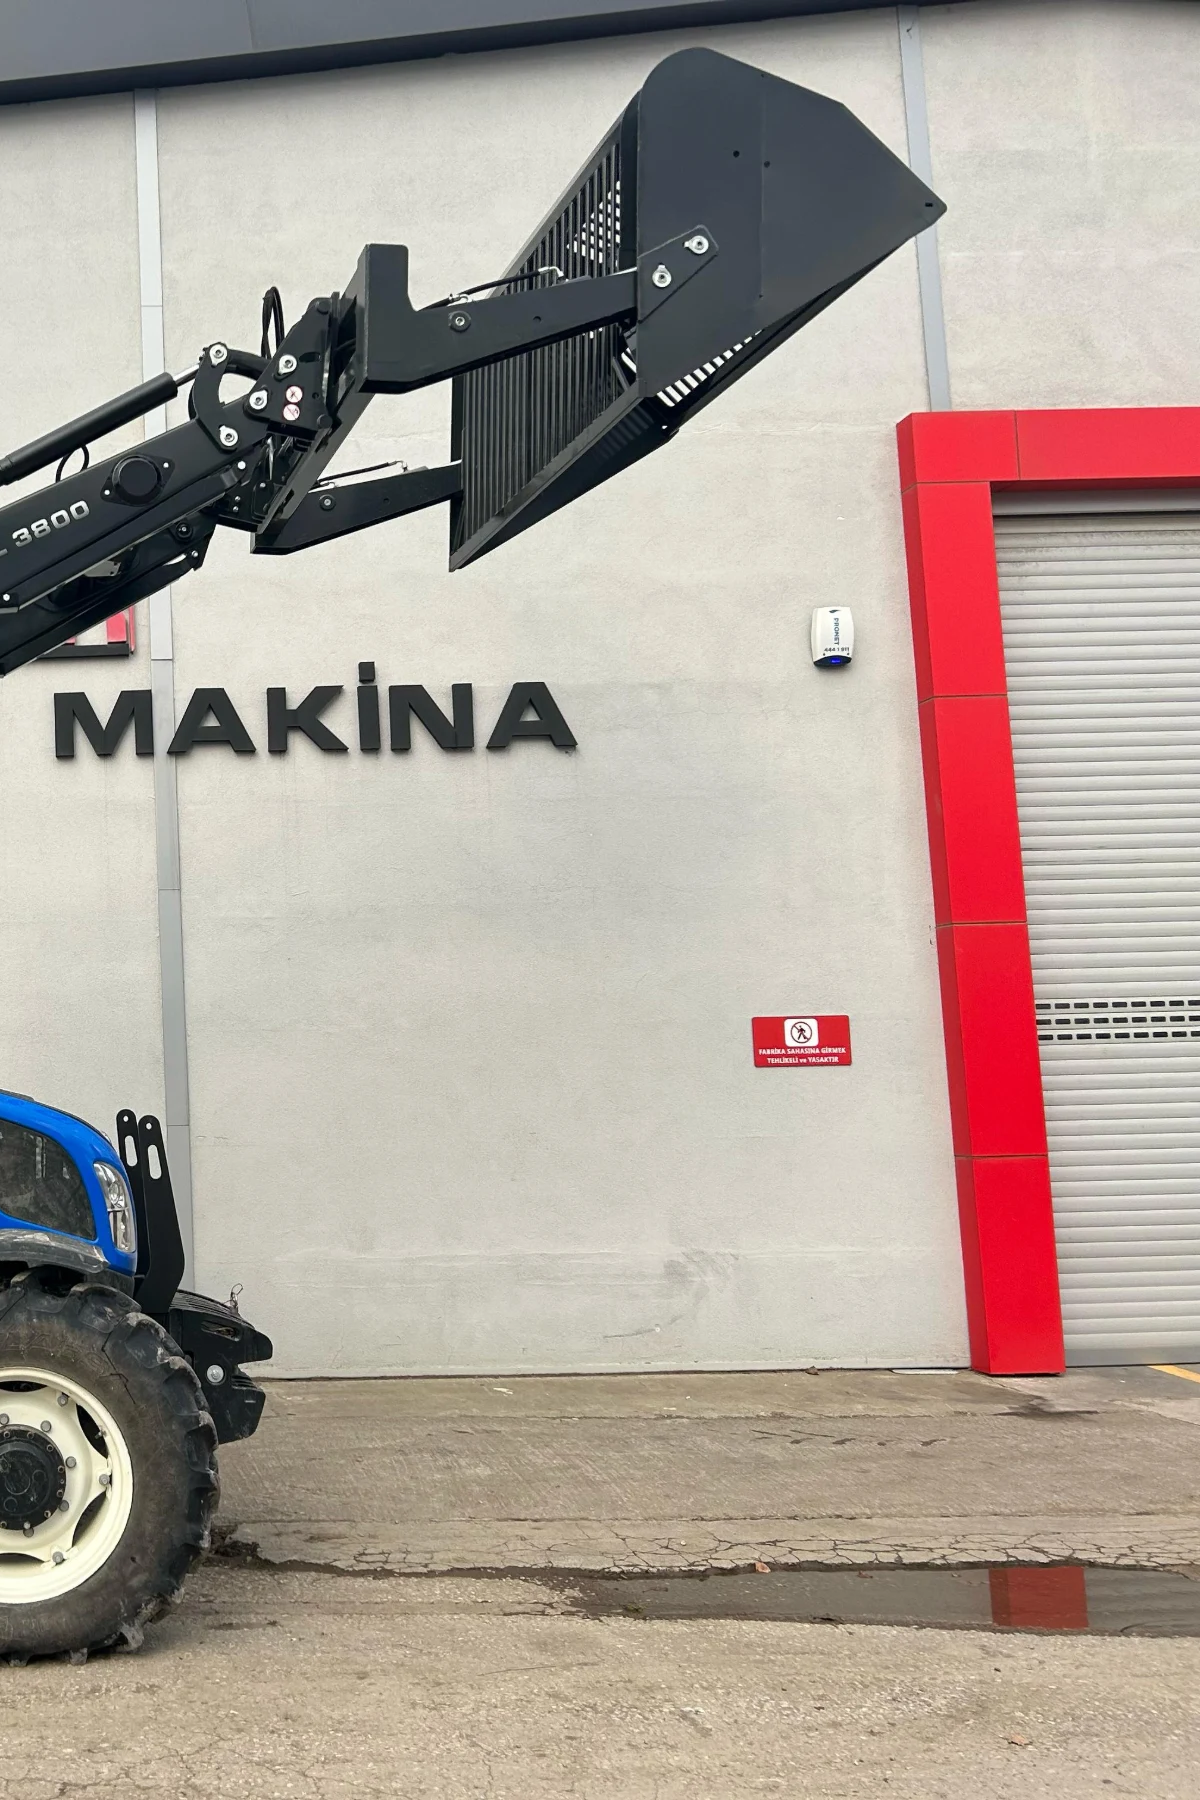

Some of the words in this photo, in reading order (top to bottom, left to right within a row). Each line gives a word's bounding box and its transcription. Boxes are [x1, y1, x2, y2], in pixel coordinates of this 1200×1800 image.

[12, 500, 90, 547] 3800
[54, 661, 578, 758] MAKİNA
[758, 1047, 786, 1056] FABRİKA
[787, 1047, 820, 1055] SAHASINA
[820, 1046, 846, 1054] GİRMEK
[766, 1056, 799, 1064] TEHLİKELİ
